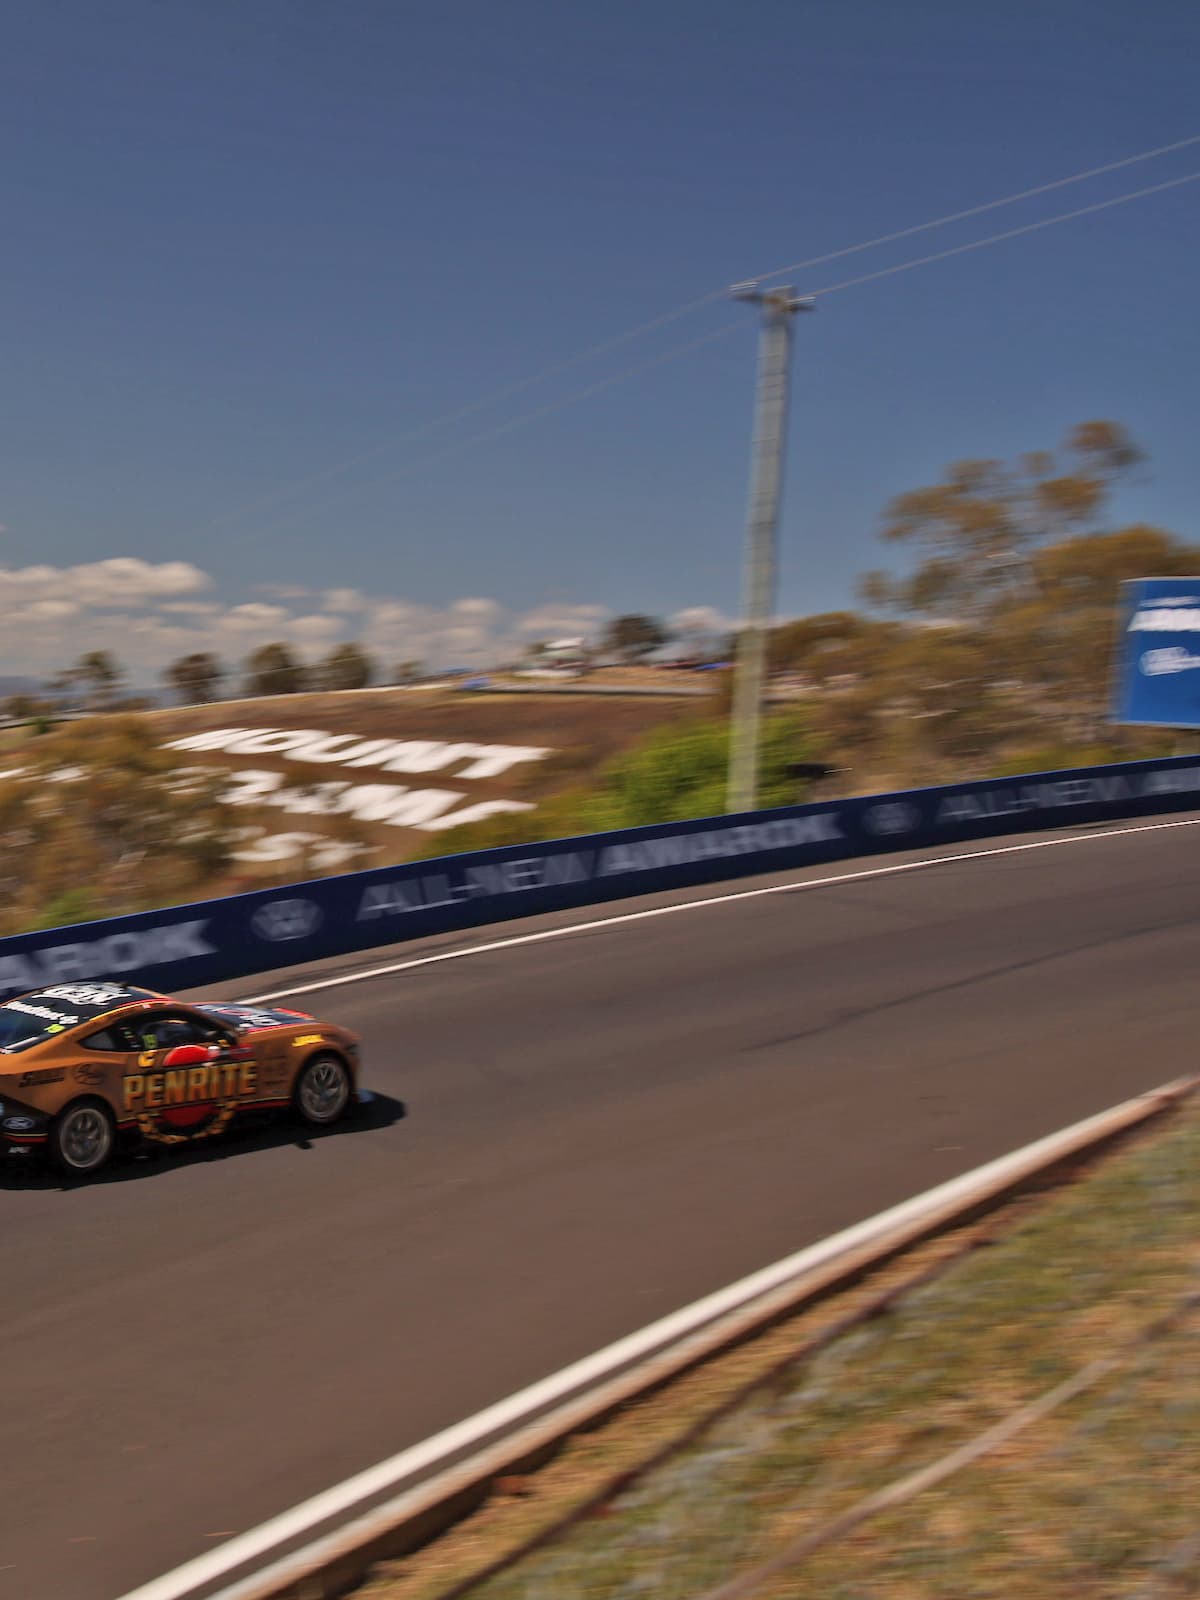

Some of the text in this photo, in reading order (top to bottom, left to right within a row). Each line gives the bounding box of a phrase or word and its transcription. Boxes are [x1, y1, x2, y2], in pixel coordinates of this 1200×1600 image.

[158, 727, 550, 779] MOUNT
[356, 850, 596, 921] ALL-NEW
[600, 812, 846, 876] AMAROK
[123, 1060, 257, 1111] PENRITE
